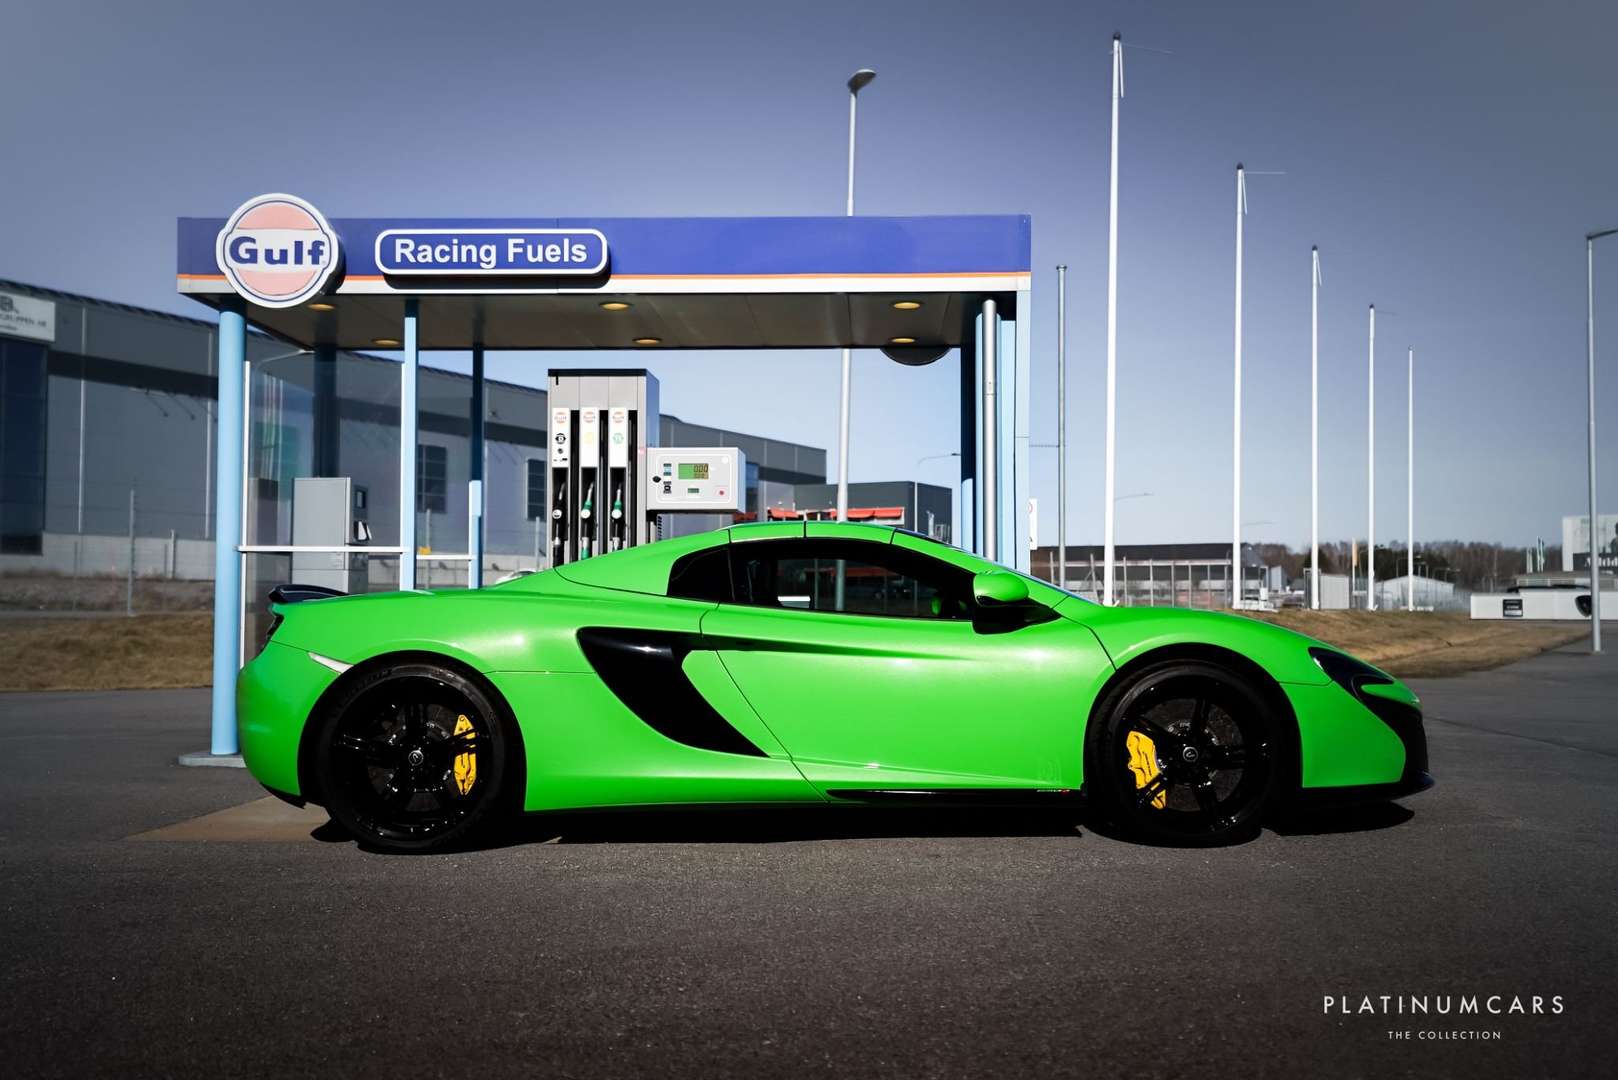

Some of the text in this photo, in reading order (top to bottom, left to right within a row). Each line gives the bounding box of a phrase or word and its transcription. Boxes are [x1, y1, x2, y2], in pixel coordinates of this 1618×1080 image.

[229, 236, 325, 266] Gulf
[394, 237, 588, 269] Racing Fuels
